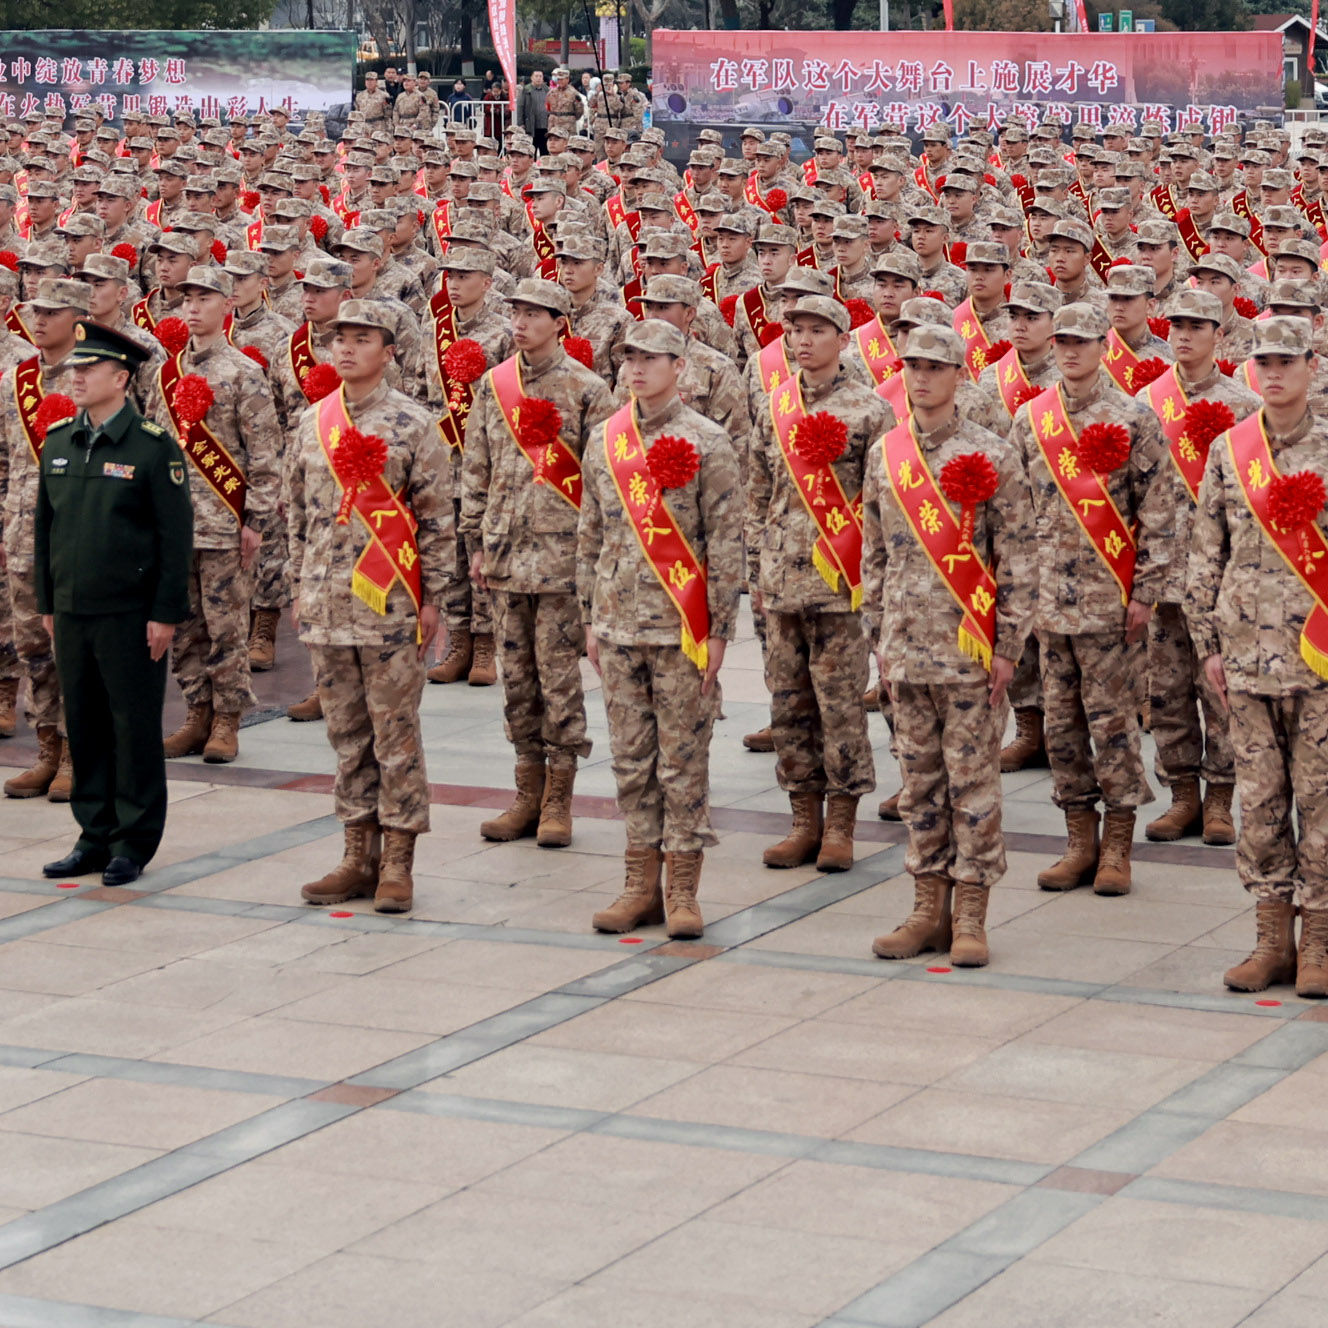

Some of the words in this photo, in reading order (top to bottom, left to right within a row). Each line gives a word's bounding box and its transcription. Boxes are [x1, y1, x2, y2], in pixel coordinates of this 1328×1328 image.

[710, 58, 1119, 96] 在军队这个大舞台上施展才华
[613, 431, 697, 591] 光荣入伍
[898, 459, 996, 616] 光荣入伍
[1041, 409, 1127, 560] 光荣入伍
